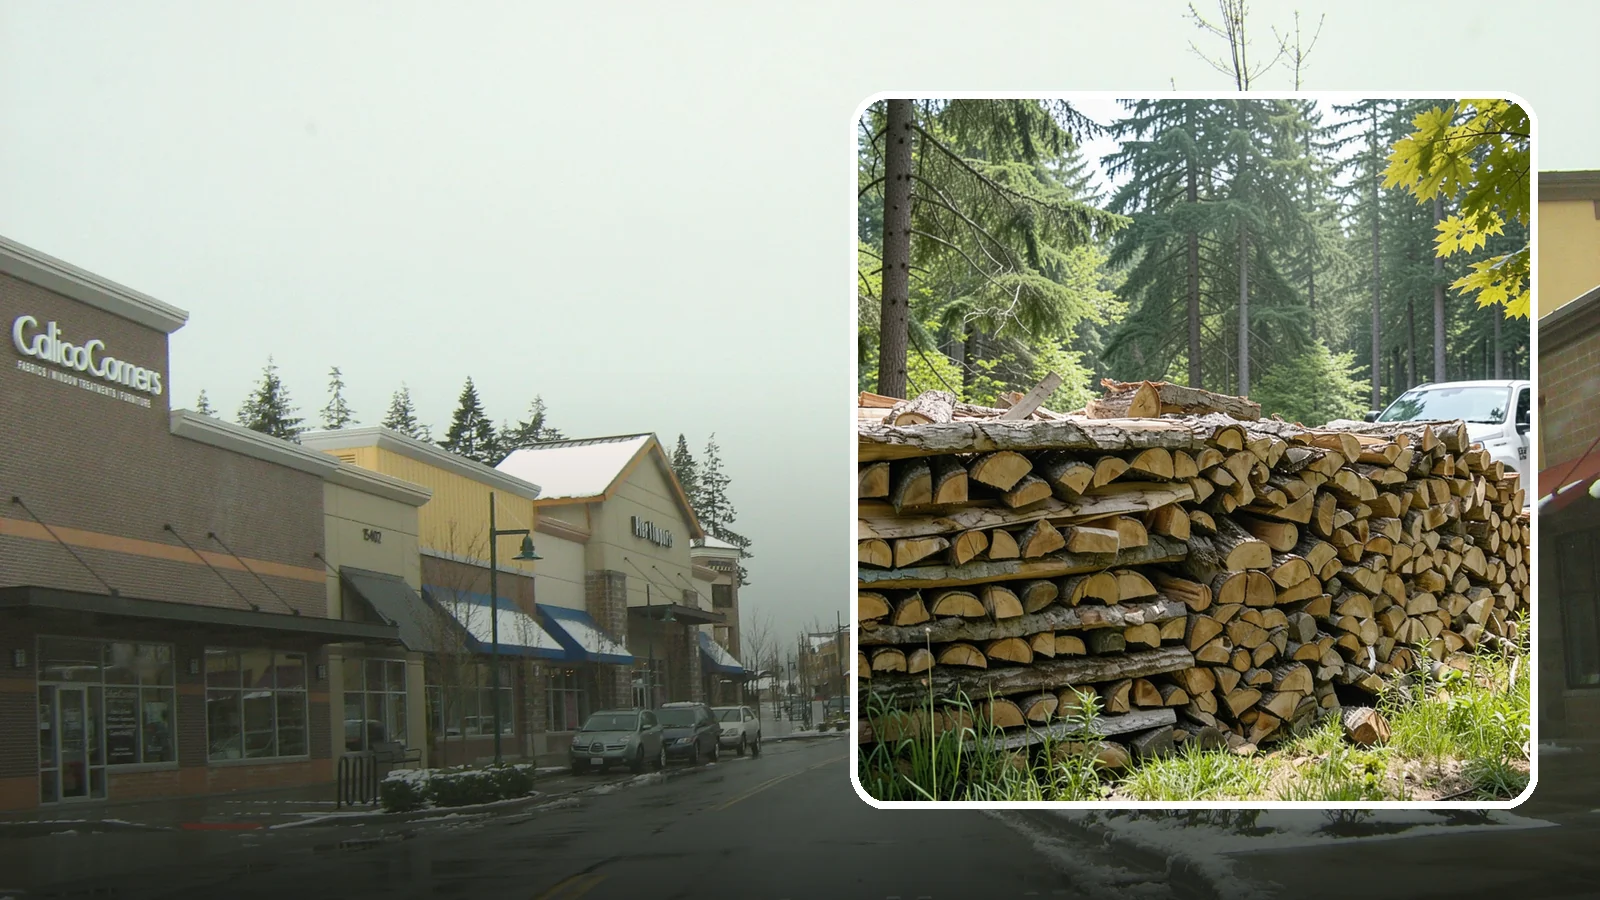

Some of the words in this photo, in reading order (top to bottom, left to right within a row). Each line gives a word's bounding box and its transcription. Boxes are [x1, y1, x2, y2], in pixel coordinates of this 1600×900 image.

[17, 360, 46, 377] FABRICS
[51, 370, 78, 386] WINDOW
[78, 378, 117, 398] TREATMENTS
[120, 390, 151, 408] FURNITURE
